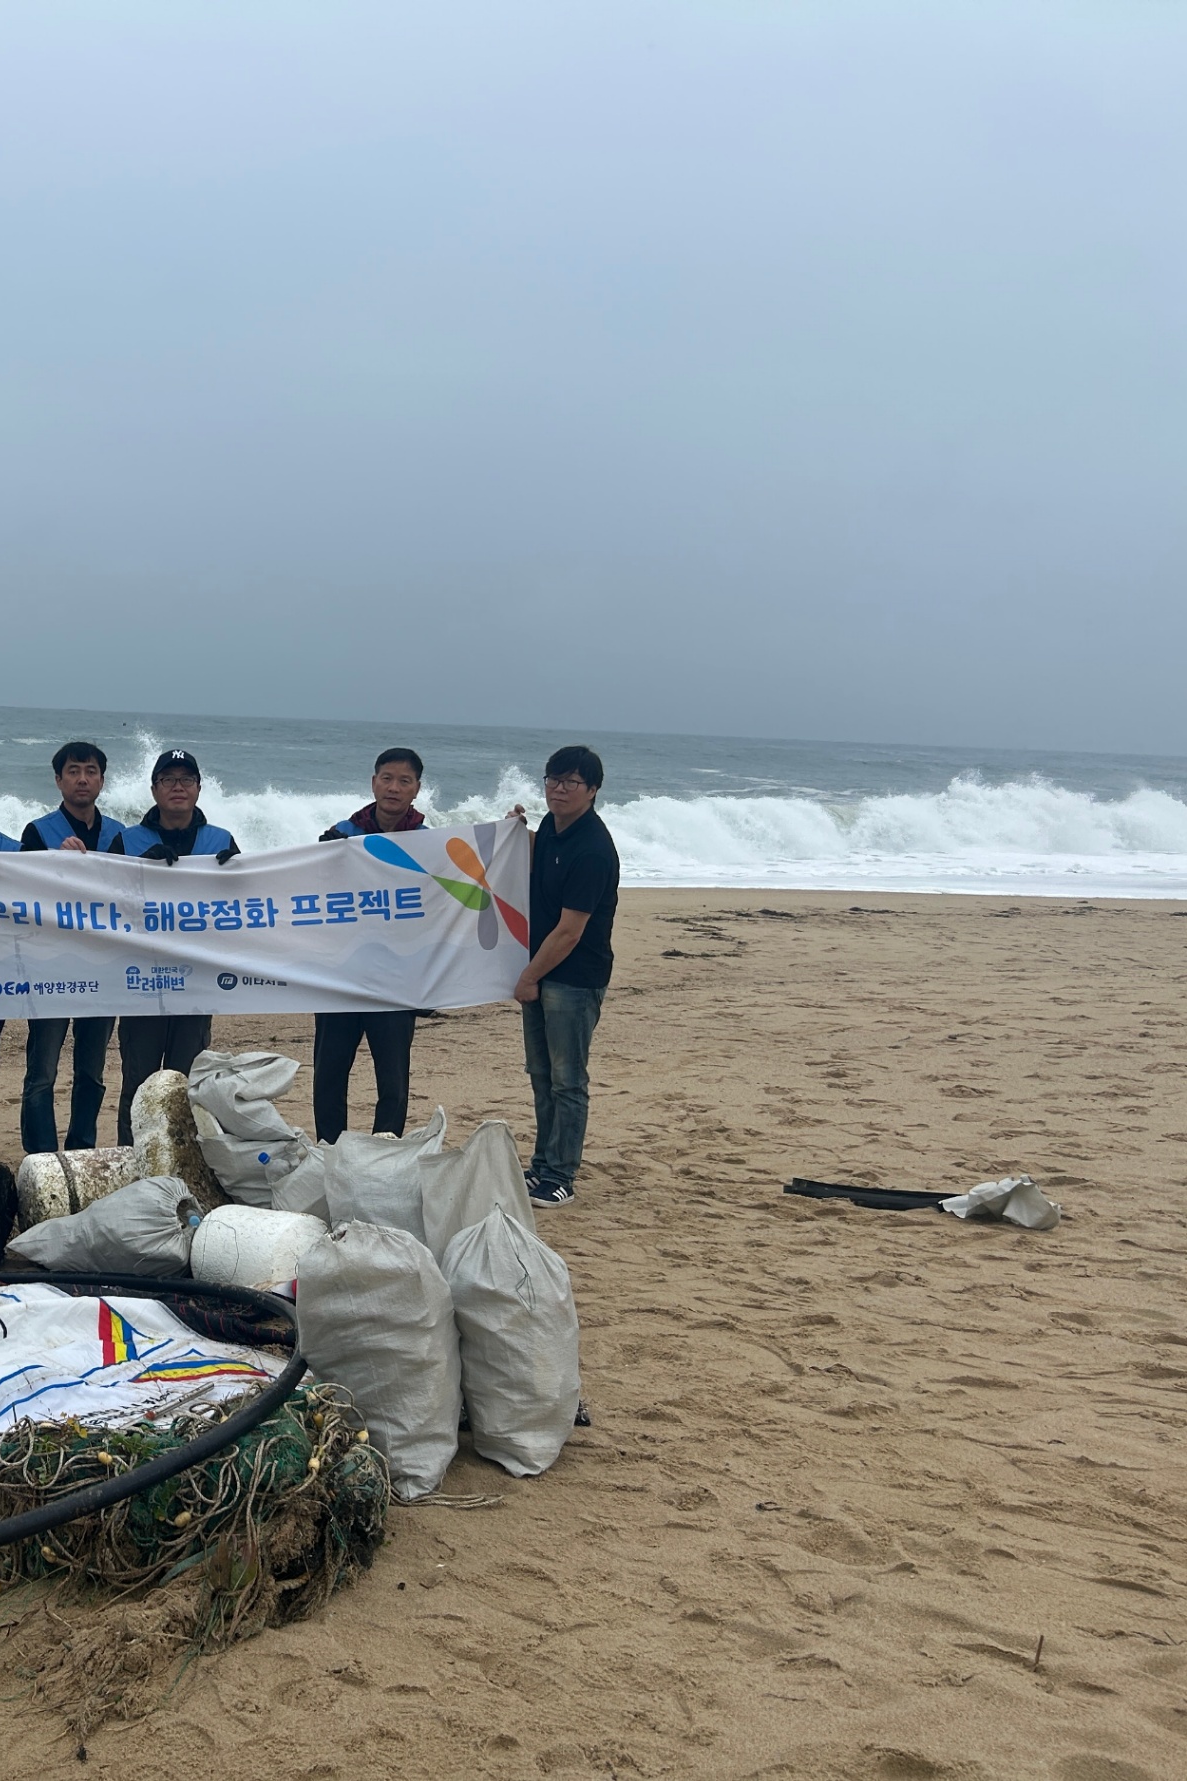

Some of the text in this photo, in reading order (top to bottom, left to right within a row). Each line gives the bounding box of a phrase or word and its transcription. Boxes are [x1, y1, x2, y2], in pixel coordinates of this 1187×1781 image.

[56, 901, 132, 932] 바다,
[142, 897, 279, 933] 해양정화
[291, 887, 425, 926] 프로젝트
[33, 980, 100, 996] 해양환경공단
[126, 974, 186, 992] 반려해변
